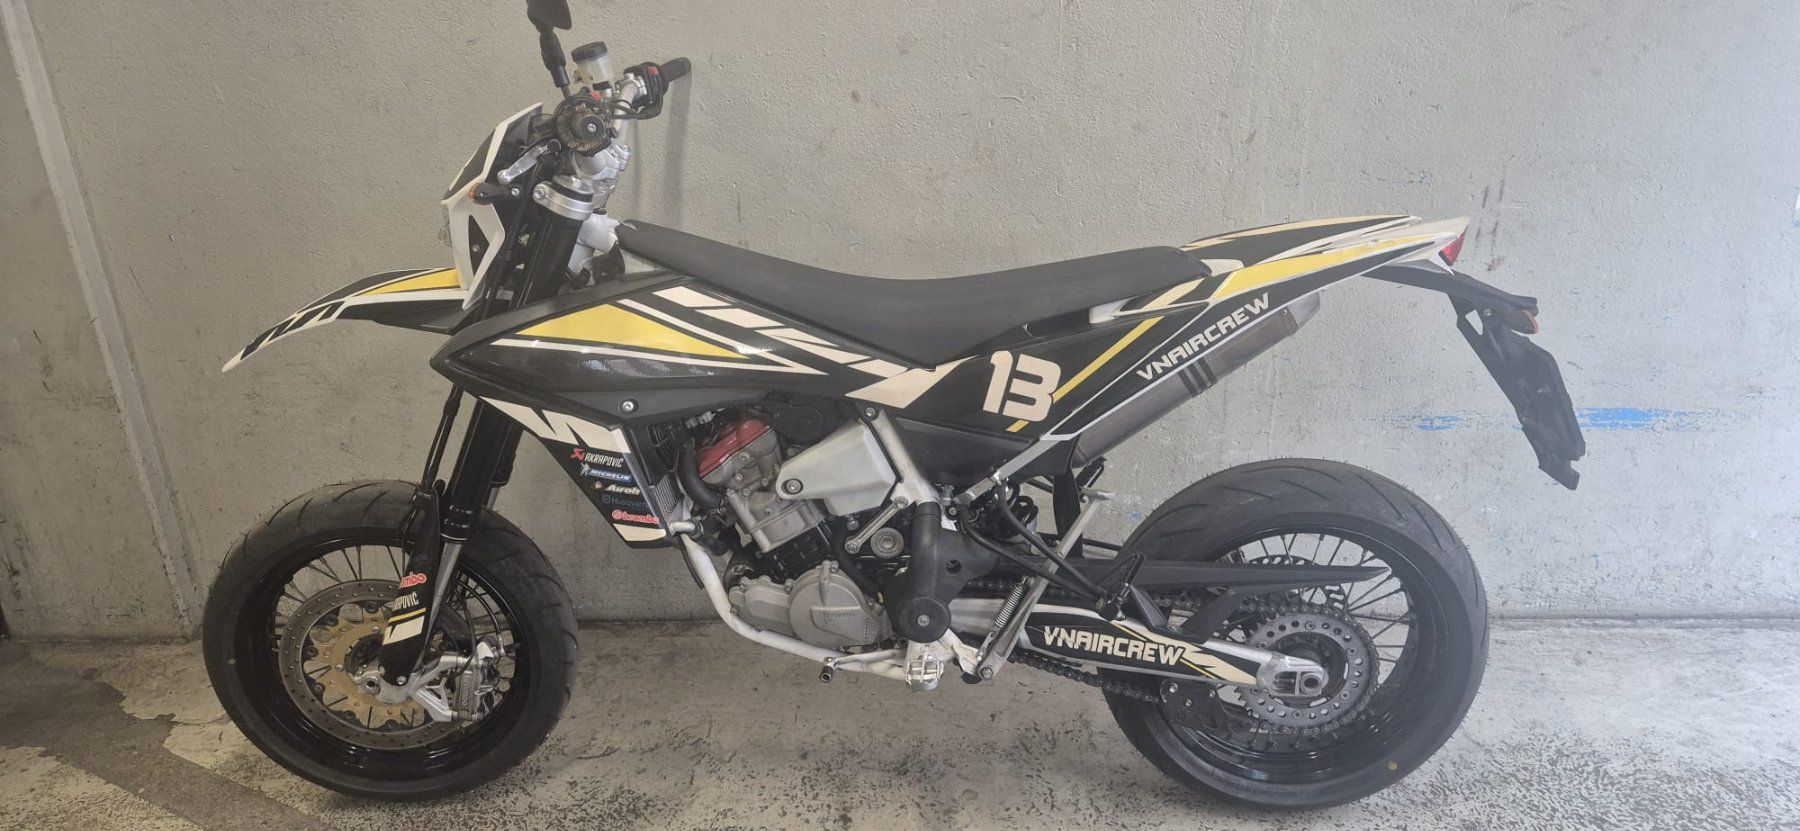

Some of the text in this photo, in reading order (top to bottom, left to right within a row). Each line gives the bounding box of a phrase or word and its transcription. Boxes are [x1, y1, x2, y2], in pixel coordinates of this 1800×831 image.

[1136, 292, 1270, 381] VNAIRCREW
[982, 350, 1061, 422] 13
[590, 469, 631, 481] MICHELIN
[1043, 626, 1185, 666] VNAIRCREW
